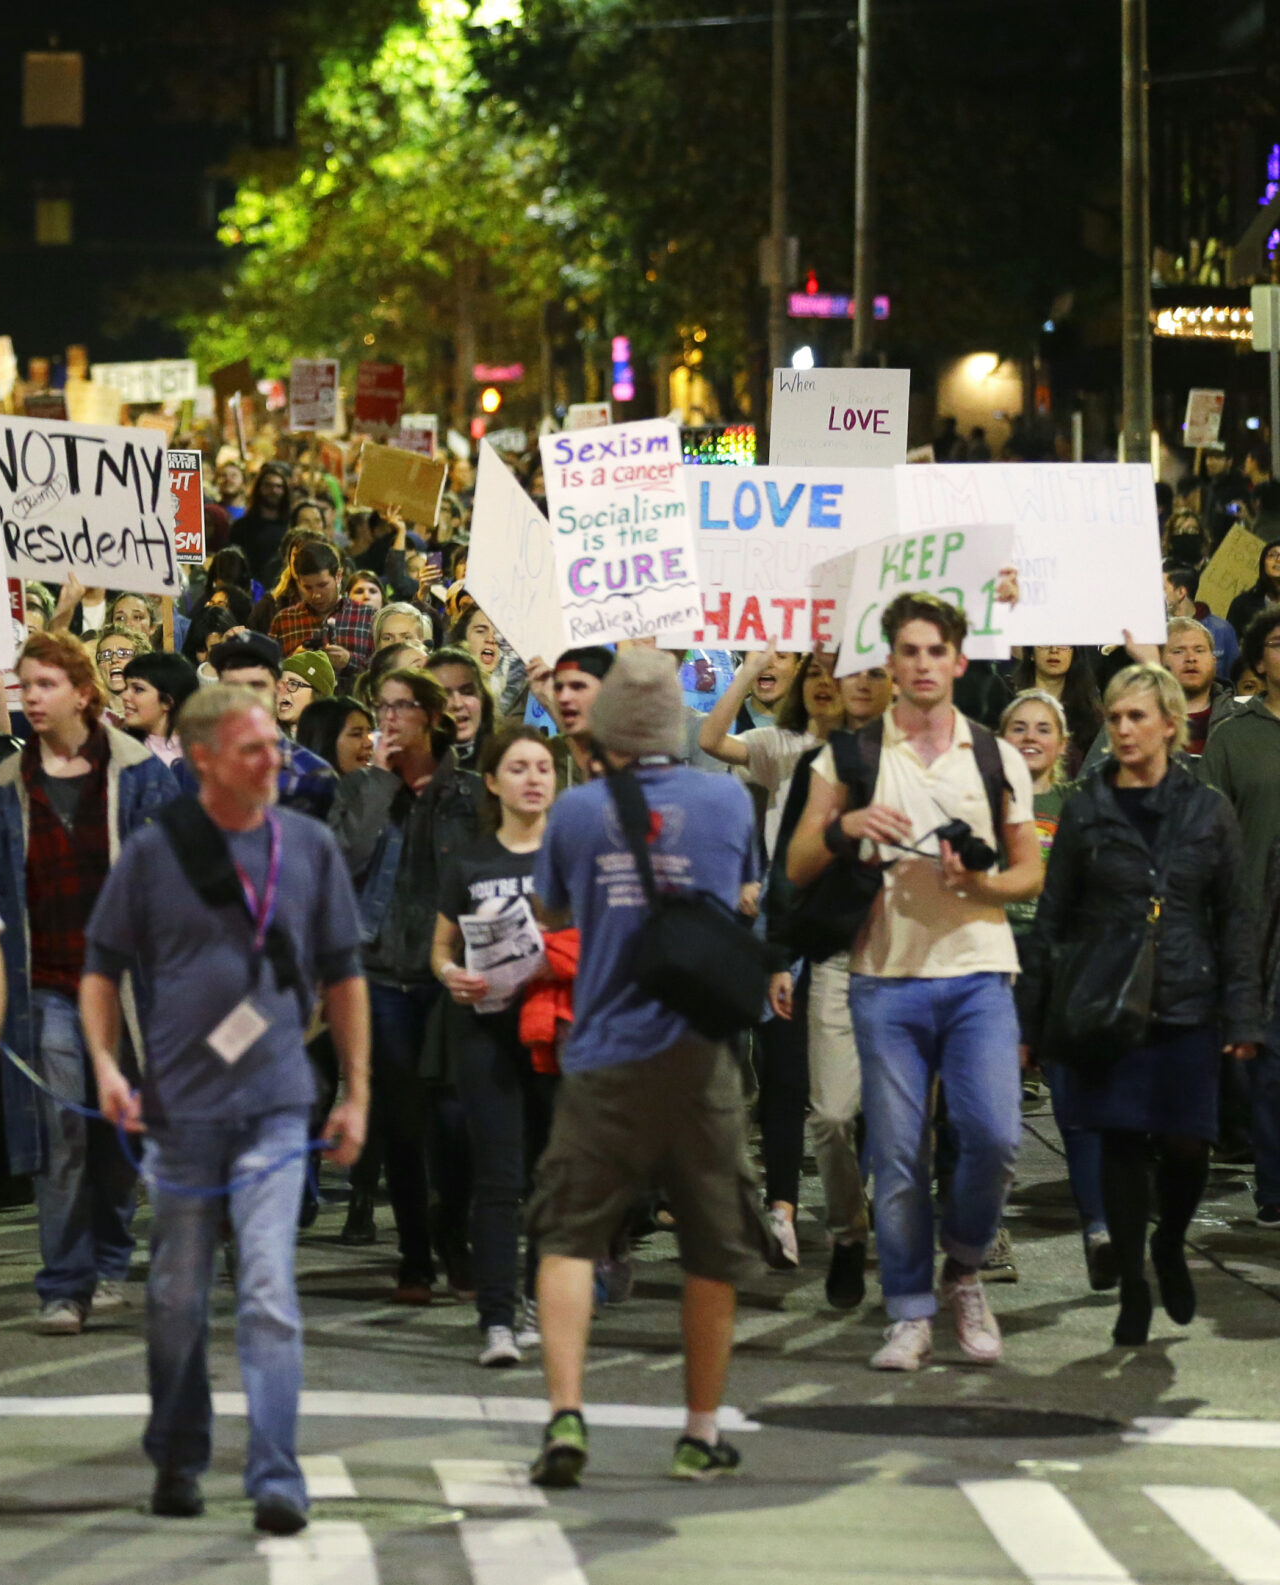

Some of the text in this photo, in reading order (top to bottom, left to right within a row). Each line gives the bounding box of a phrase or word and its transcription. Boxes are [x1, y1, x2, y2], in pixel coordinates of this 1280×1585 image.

[780, 370, 816, 392] When
[828, 406, 890, 434] LOVE
[554, 433, 668, 466] Sexism
[95, 442, 163, 516] MY
[562, 462, 683, 488] is a cancer
[558, 494, 686, 535] Socialism
[700, 480, 844, 531] LOVE
[582, 526, 658, 552] is the
[568, 548, 687, 597] CURE
[879, 532, 965, 590] KEEP
[570, 600, 642, 641] Radical
[693, 592, 836, 642] HATE
